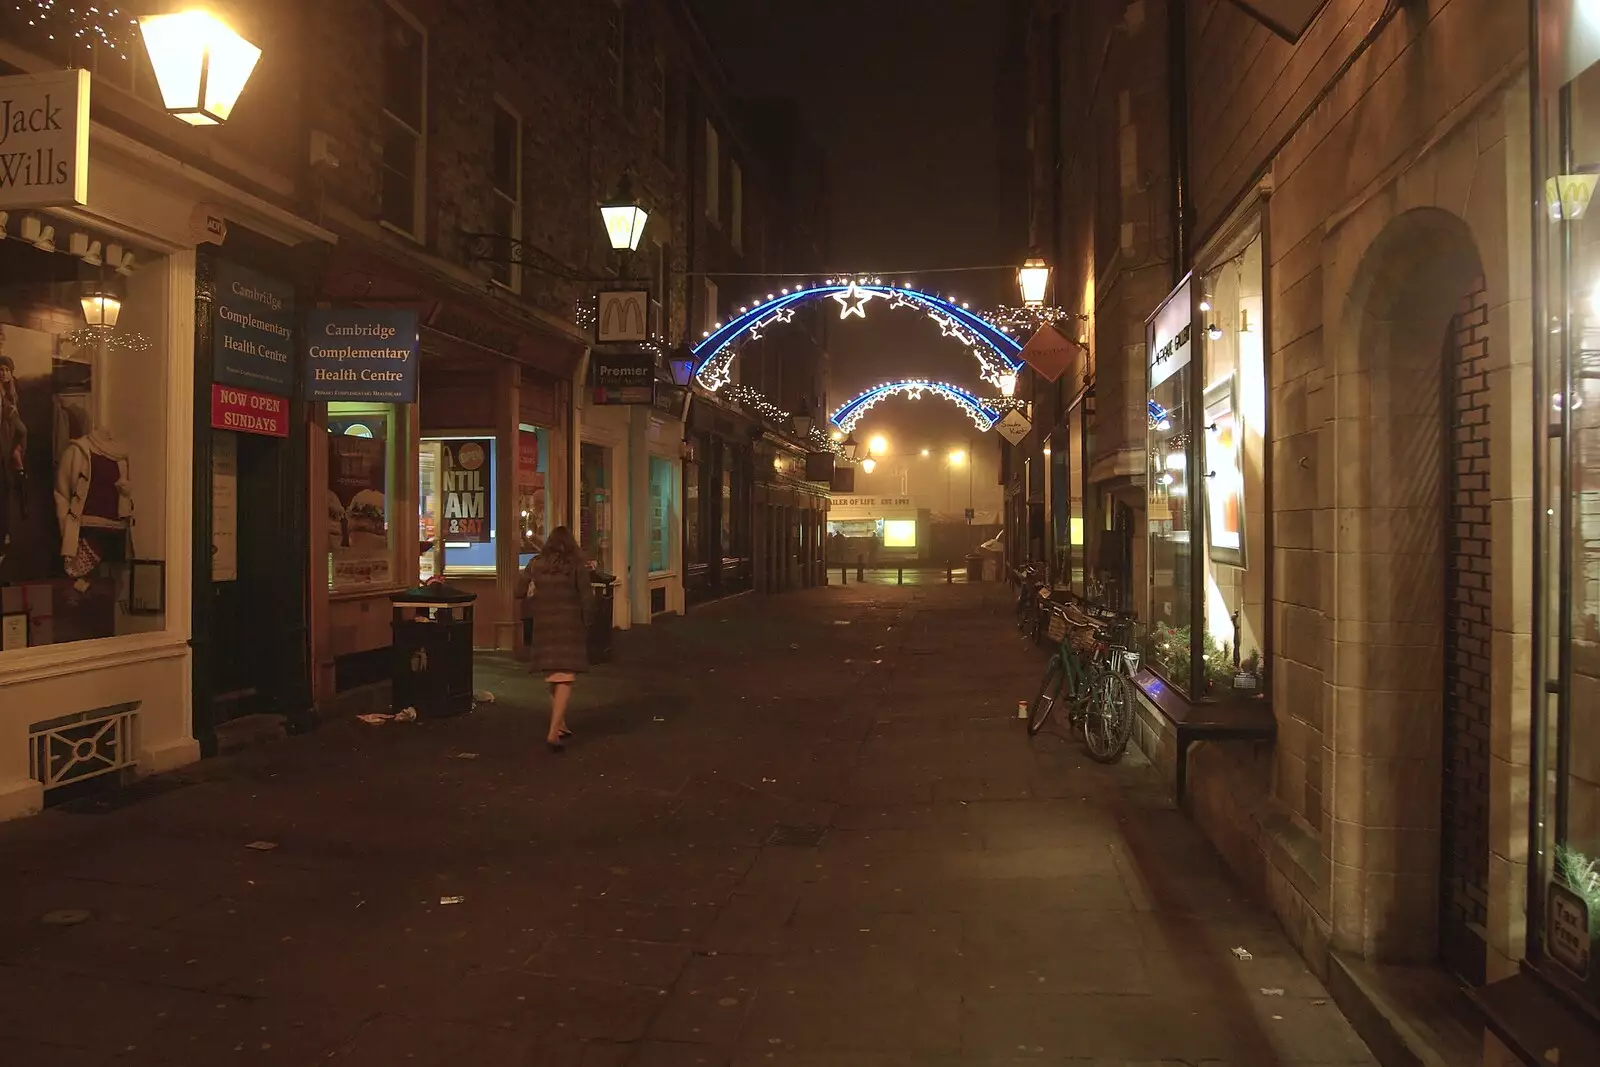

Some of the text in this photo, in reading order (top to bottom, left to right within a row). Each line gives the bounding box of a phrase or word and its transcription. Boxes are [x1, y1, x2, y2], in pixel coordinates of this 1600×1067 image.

[0, 93, 62, 145] Jack
[0, 147, 68, 188] Wills
[231, 281, 282, 310] Cambridge
[219, 305, 292, 341] Complementary
[325, 323, 396, 340] Cambridge
[224, 335, 288, 363] Health Centre
[309, 345, 411, 363] Complementary
[314, 368, 403, 382] Health Centre
[600, 365, 649, 377] Premier
[220, 389, 281, 413] NOW OPEN
[224, 412, 277, 432] SUNDAYS
[849, 498, 859, 506] OF
[860, 498, 876, 506] LIFE
[1558, 902, 1578, 928] Tax
[1556, 920, 1579, 948] Free
